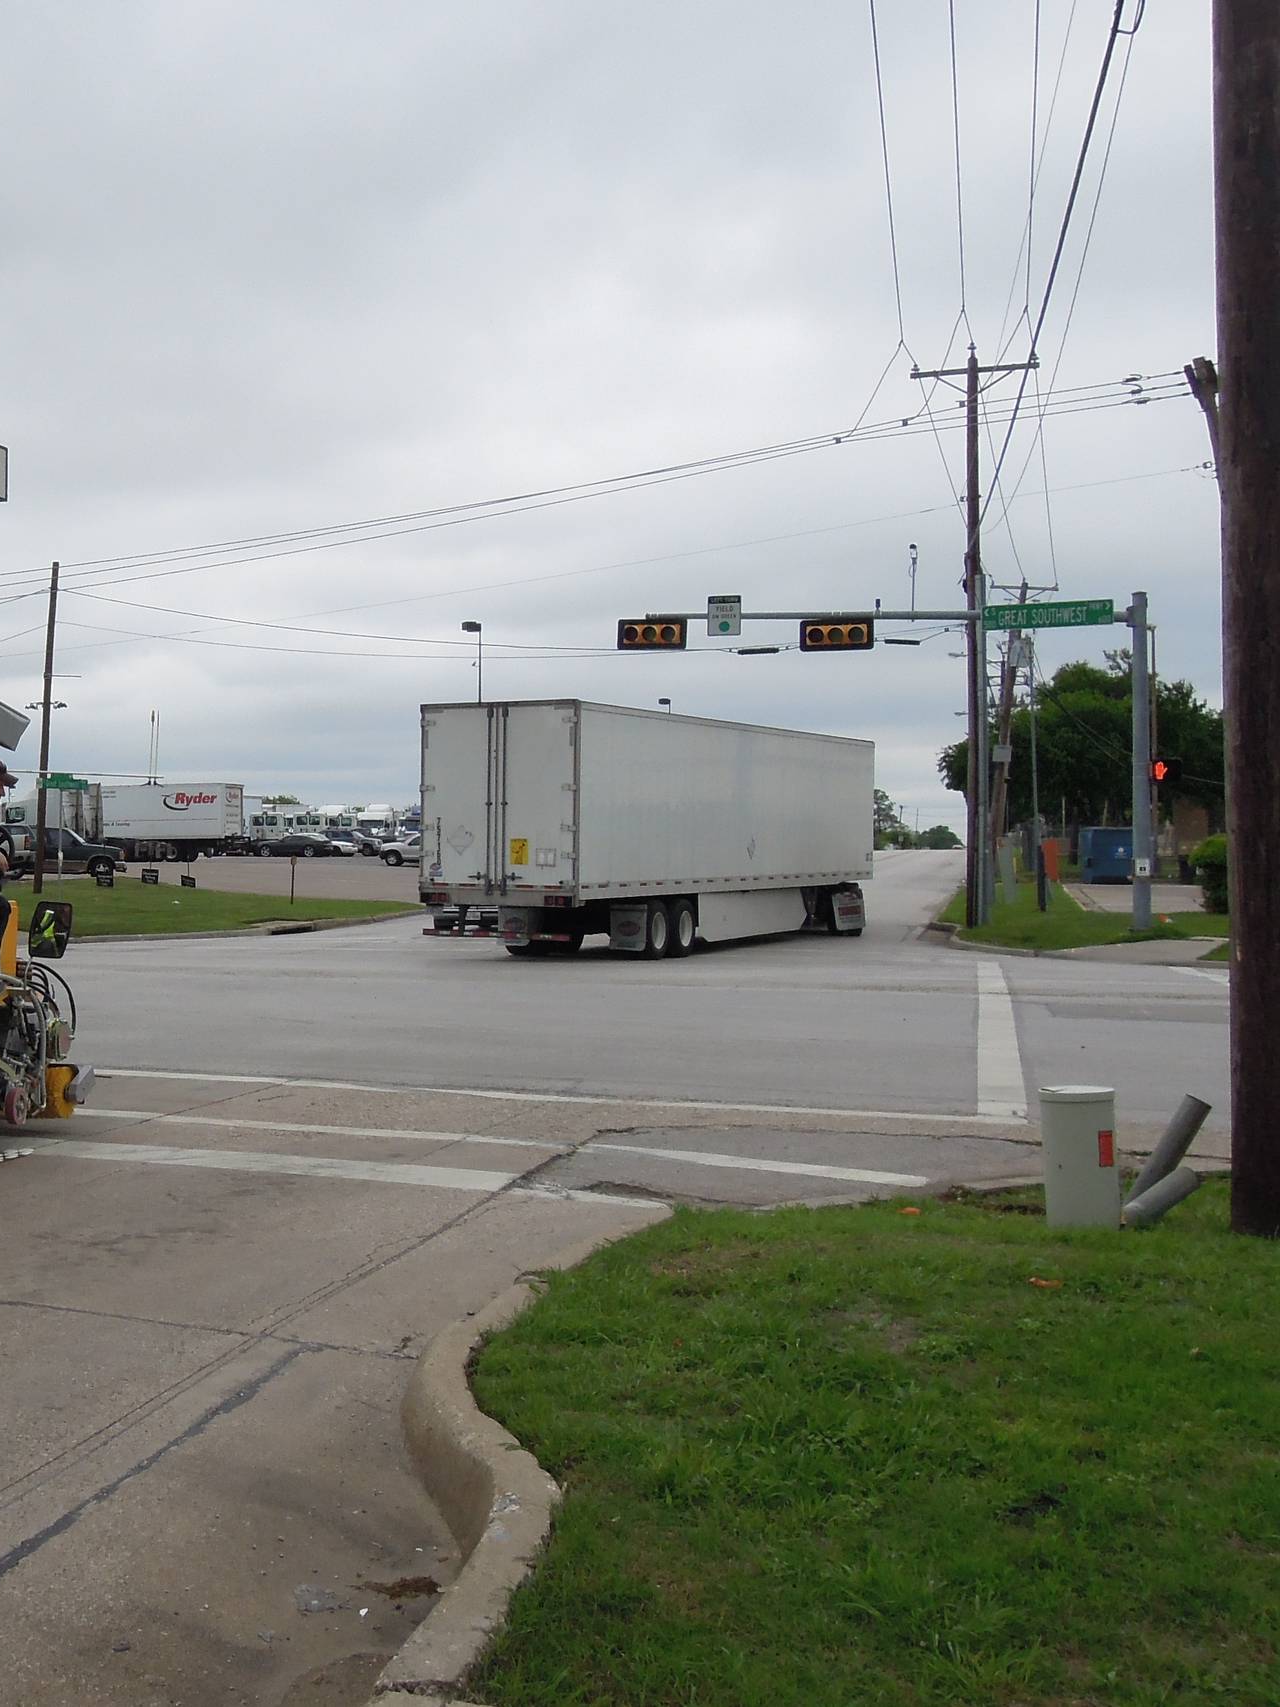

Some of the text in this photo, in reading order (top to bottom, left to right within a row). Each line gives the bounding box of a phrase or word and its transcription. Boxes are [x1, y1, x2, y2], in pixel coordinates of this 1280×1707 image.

[998, 609, 1028, 626] GREAT
[1031, 606, 1088, 625] SOUTHWEST
[175, 792, 218, 807] Ryder
